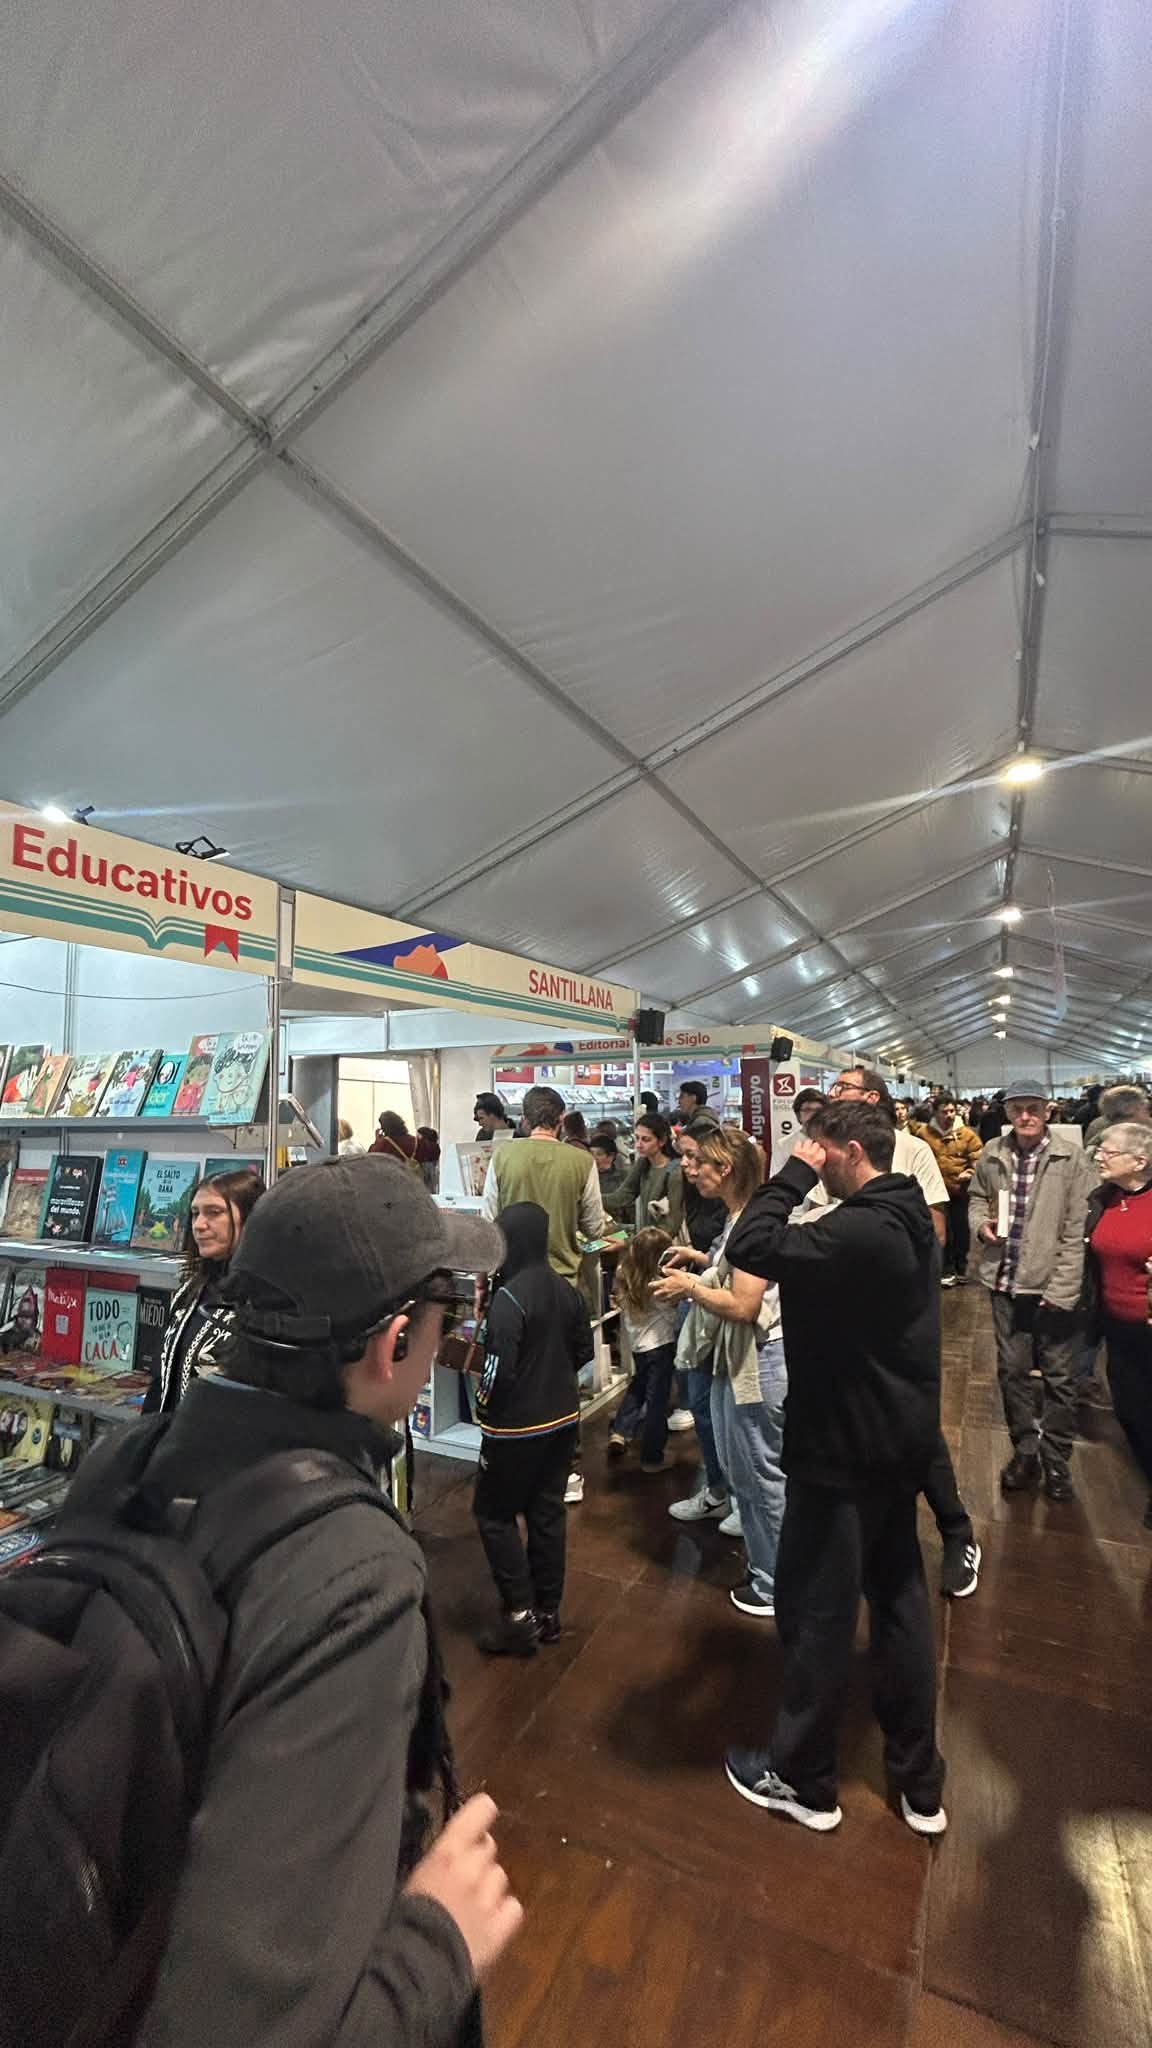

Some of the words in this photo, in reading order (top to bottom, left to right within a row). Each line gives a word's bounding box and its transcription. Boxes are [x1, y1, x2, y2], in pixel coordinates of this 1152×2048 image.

[12, 823, 252, 920] Educativos
[528, 968, 614, 1012] SANTILLANA
[676, 1032, 711, 1048] Siglo
[88, 1299, 120, 1321] TODO
[85, 1338, 119, 1361] CACA
